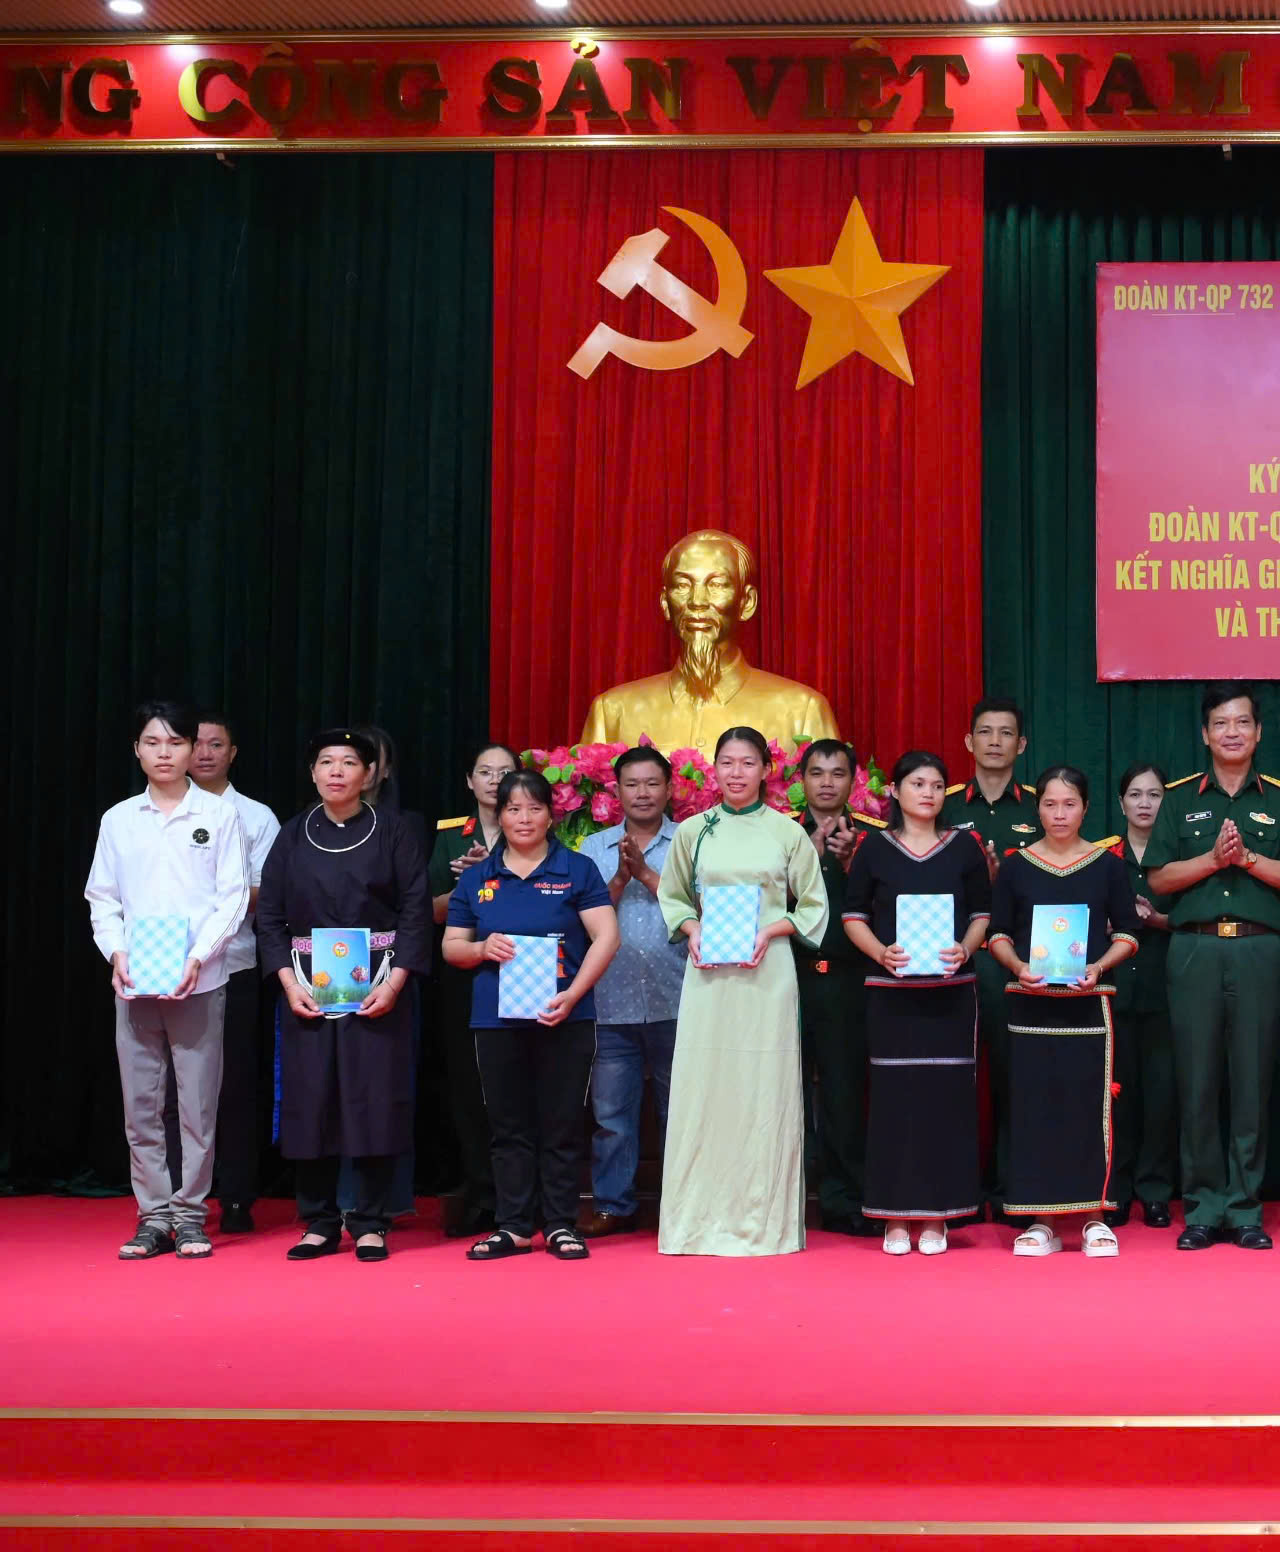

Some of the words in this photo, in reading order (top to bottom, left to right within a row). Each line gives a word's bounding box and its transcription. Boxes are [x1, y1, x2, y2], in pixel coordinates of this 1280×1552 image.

[490, 36, 682, 121] SẢN
[727, 36, 970, 133] VIỆT
[1016, 51, 1250, 116] NAM
[1114, 280, 1167, 310] ĐOÀN
[1174, 283, 1232, 313] KT-QP
[1238, 283, 1274, 310] 732
[1149, 505, 1220, 543] ĐOÀN
[1115, 550, 1162, 591] KẾT
[1171, 553, 1250, 590] NGHĨA
[1215, 600, 1248, 638] VÀ
